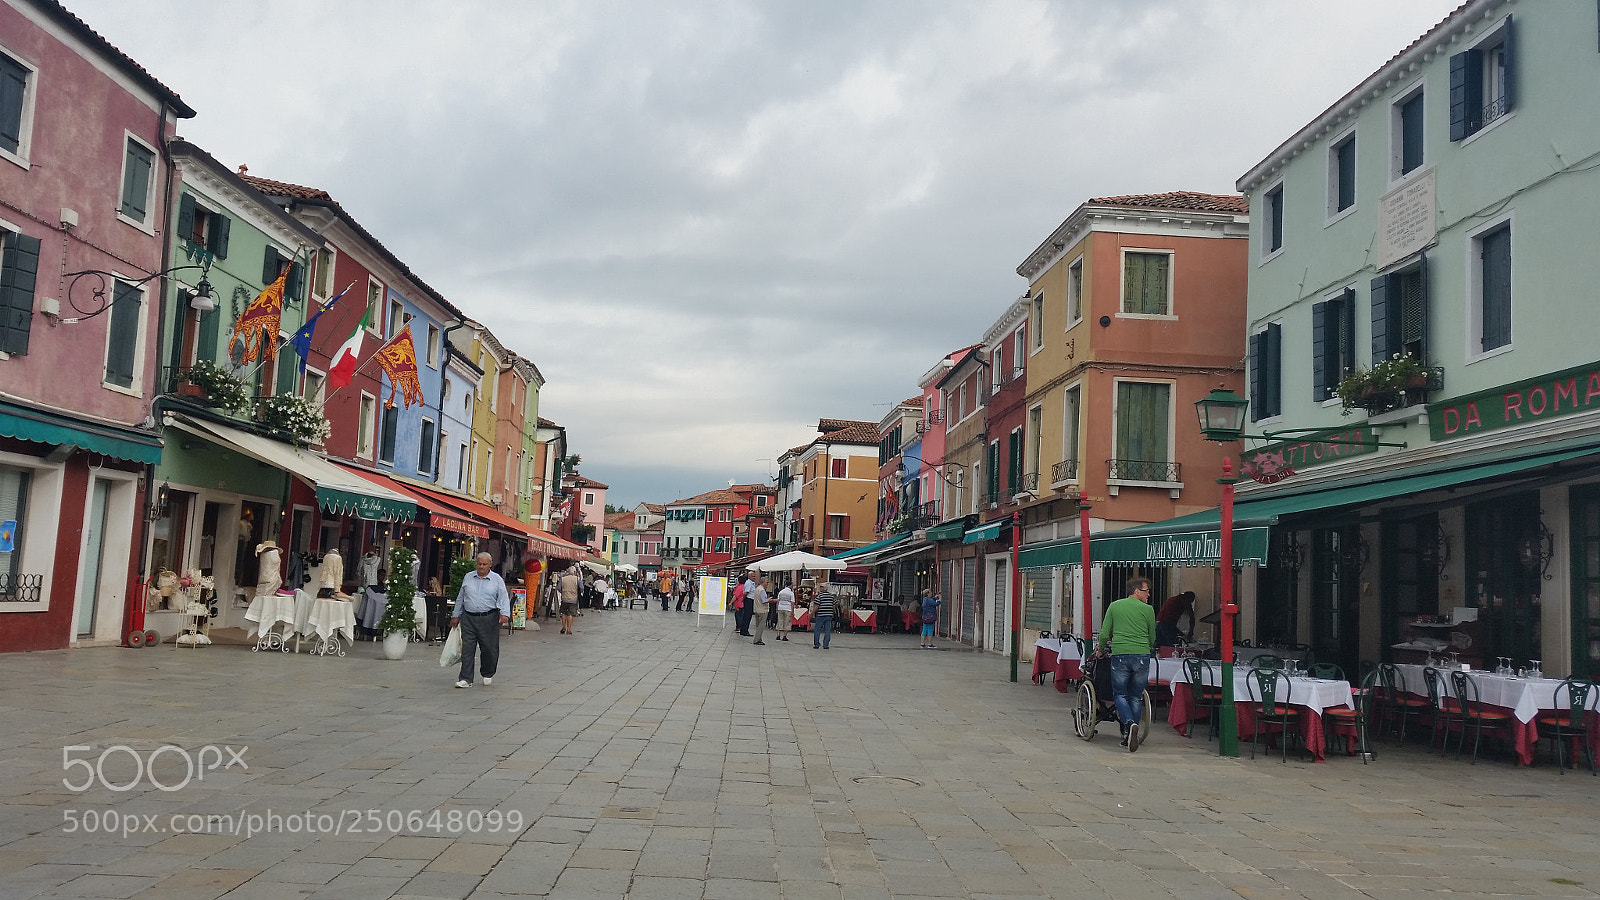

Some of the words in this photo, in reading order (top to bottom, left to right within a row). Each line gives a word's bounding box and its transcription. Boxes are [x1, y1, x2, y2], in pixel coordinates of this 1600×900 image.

[1443, 401, 1482, 435] DA
[442, 517, 466, 532] LAGUNA
[467, 524, 480, 535] BAR
[1146, 537, 1166, 560] LOCALI
[1167, 535, 1194, 558] STORICI
